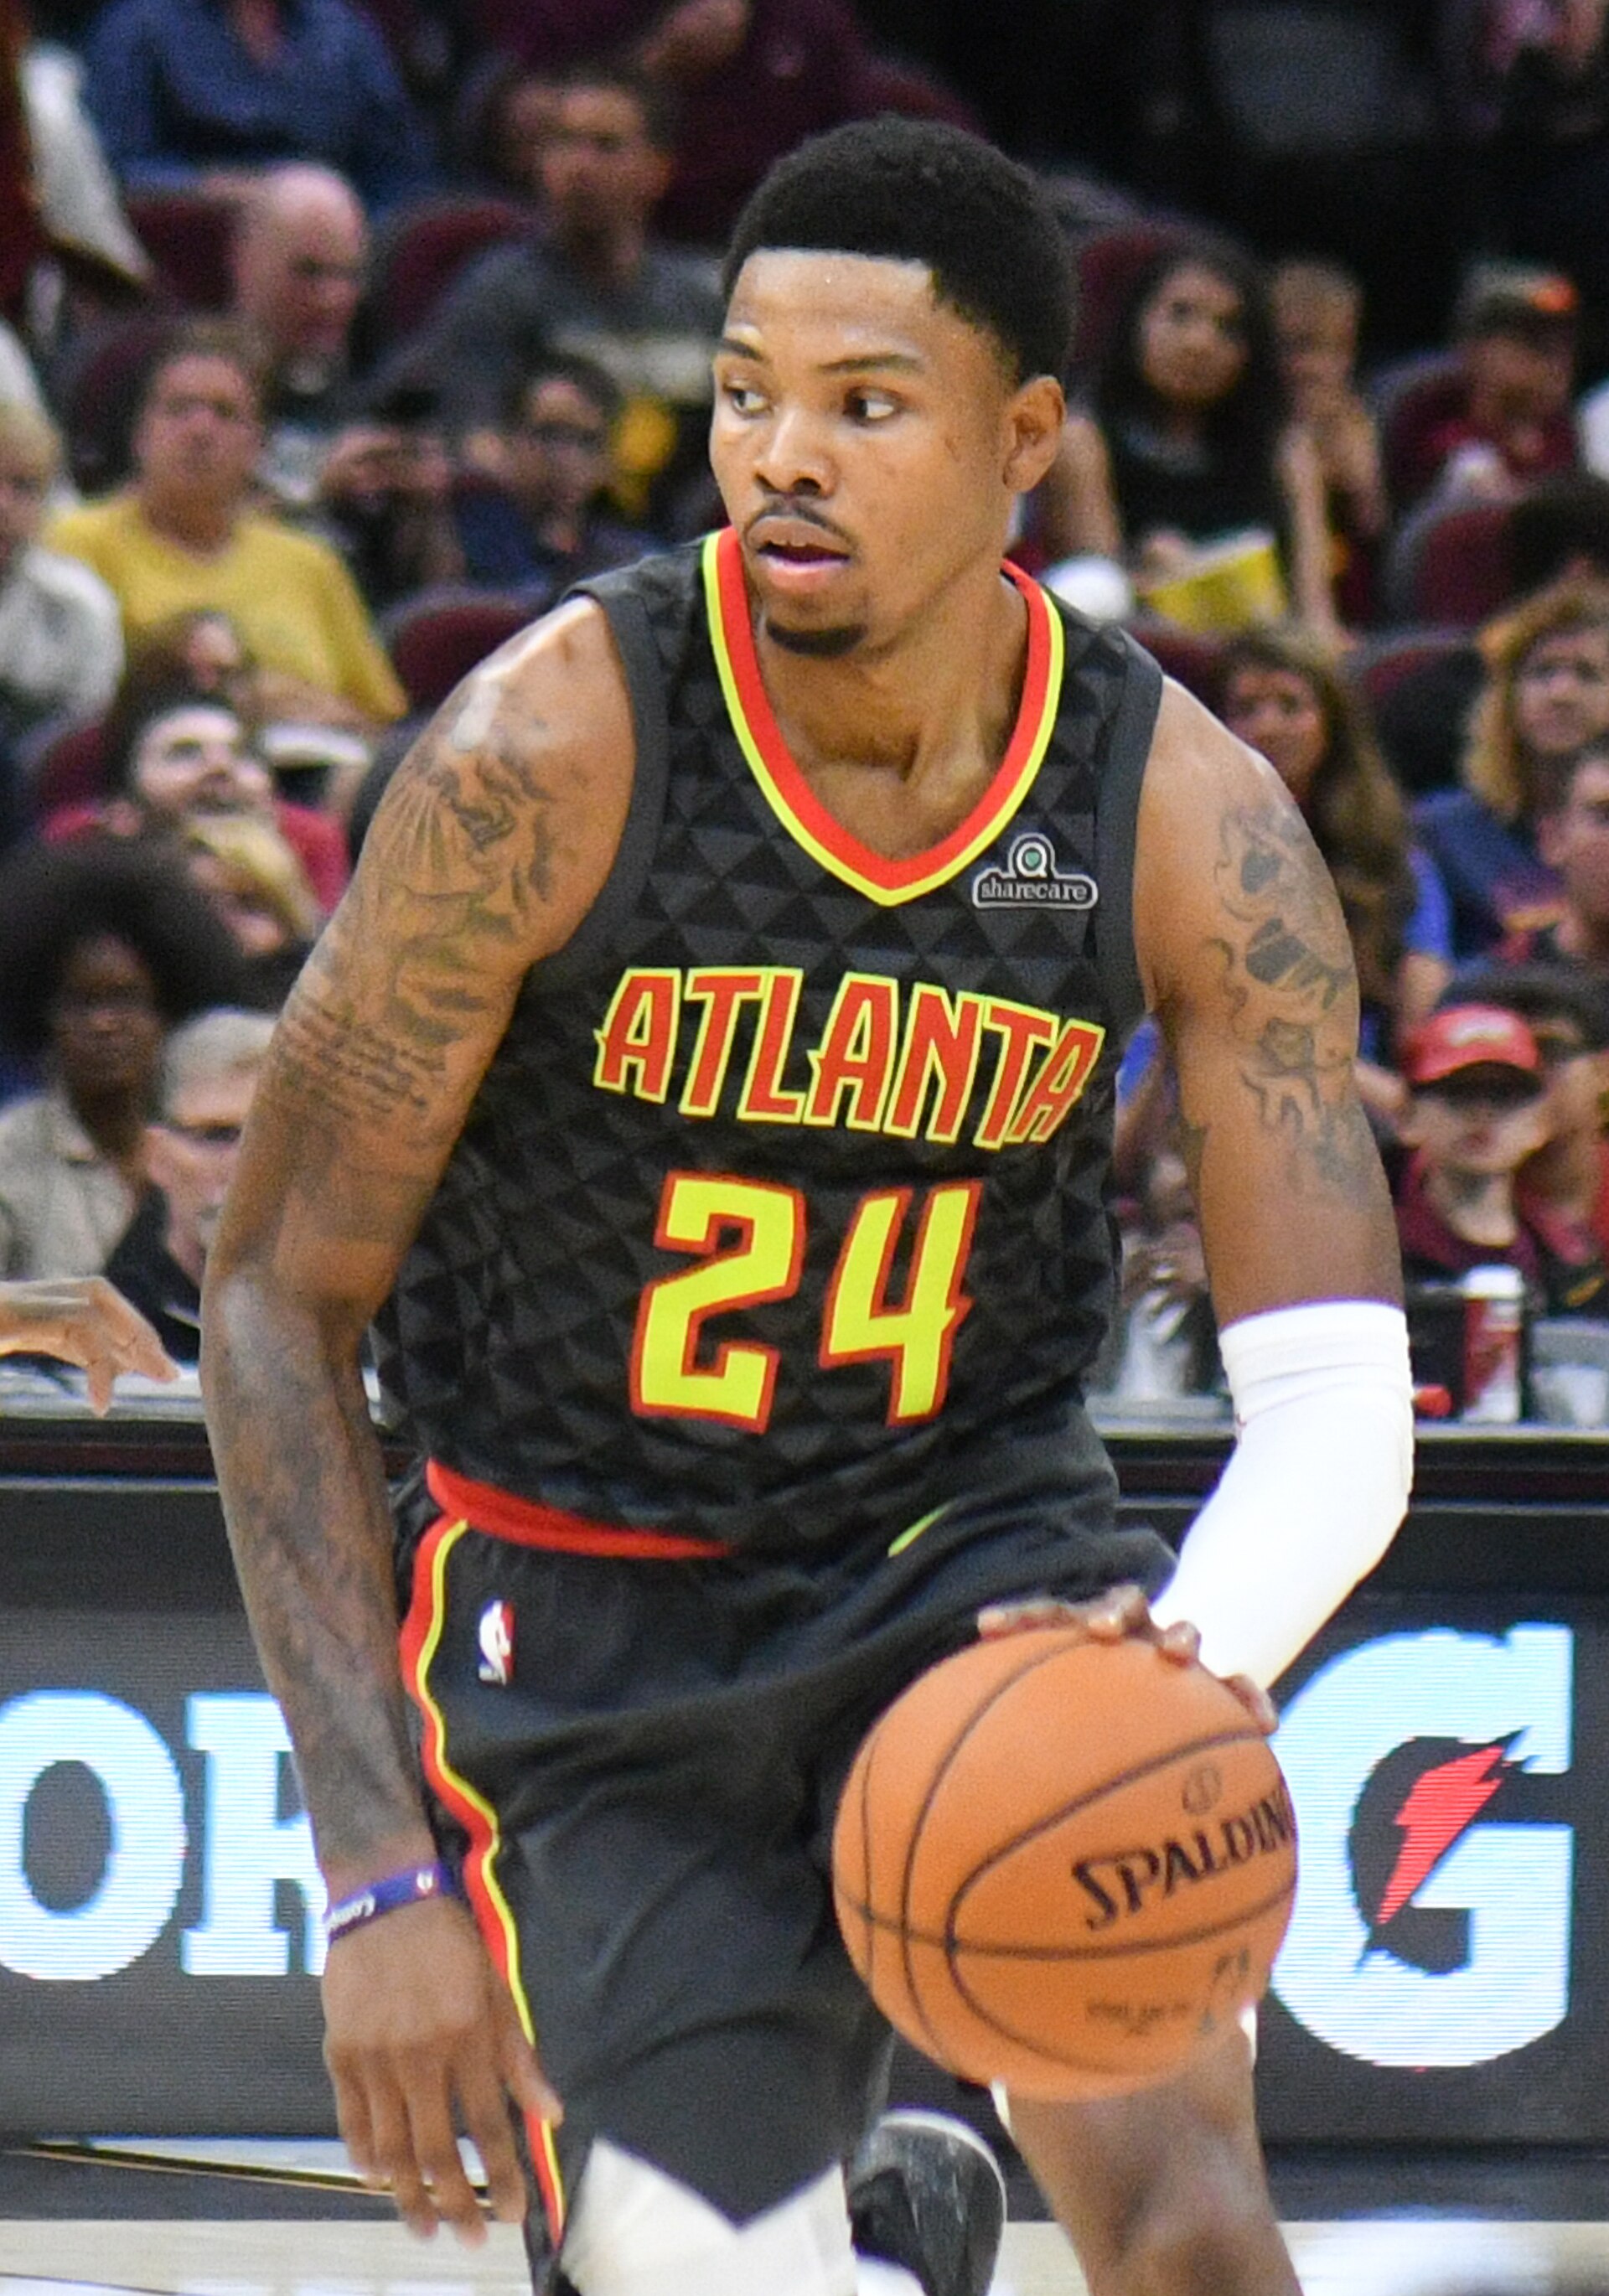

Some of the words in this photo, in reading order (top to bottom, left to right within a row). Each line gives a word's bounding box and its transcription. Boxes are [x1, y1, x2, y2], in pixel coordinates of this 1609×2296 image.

[981, 877, 1087, 901] sharecare
[593, 967, 1106, 1151] ATLANTA
[631, 1169, 982, 1434] 24
[1071, 1788, 1295, 1930] SPALDIN
